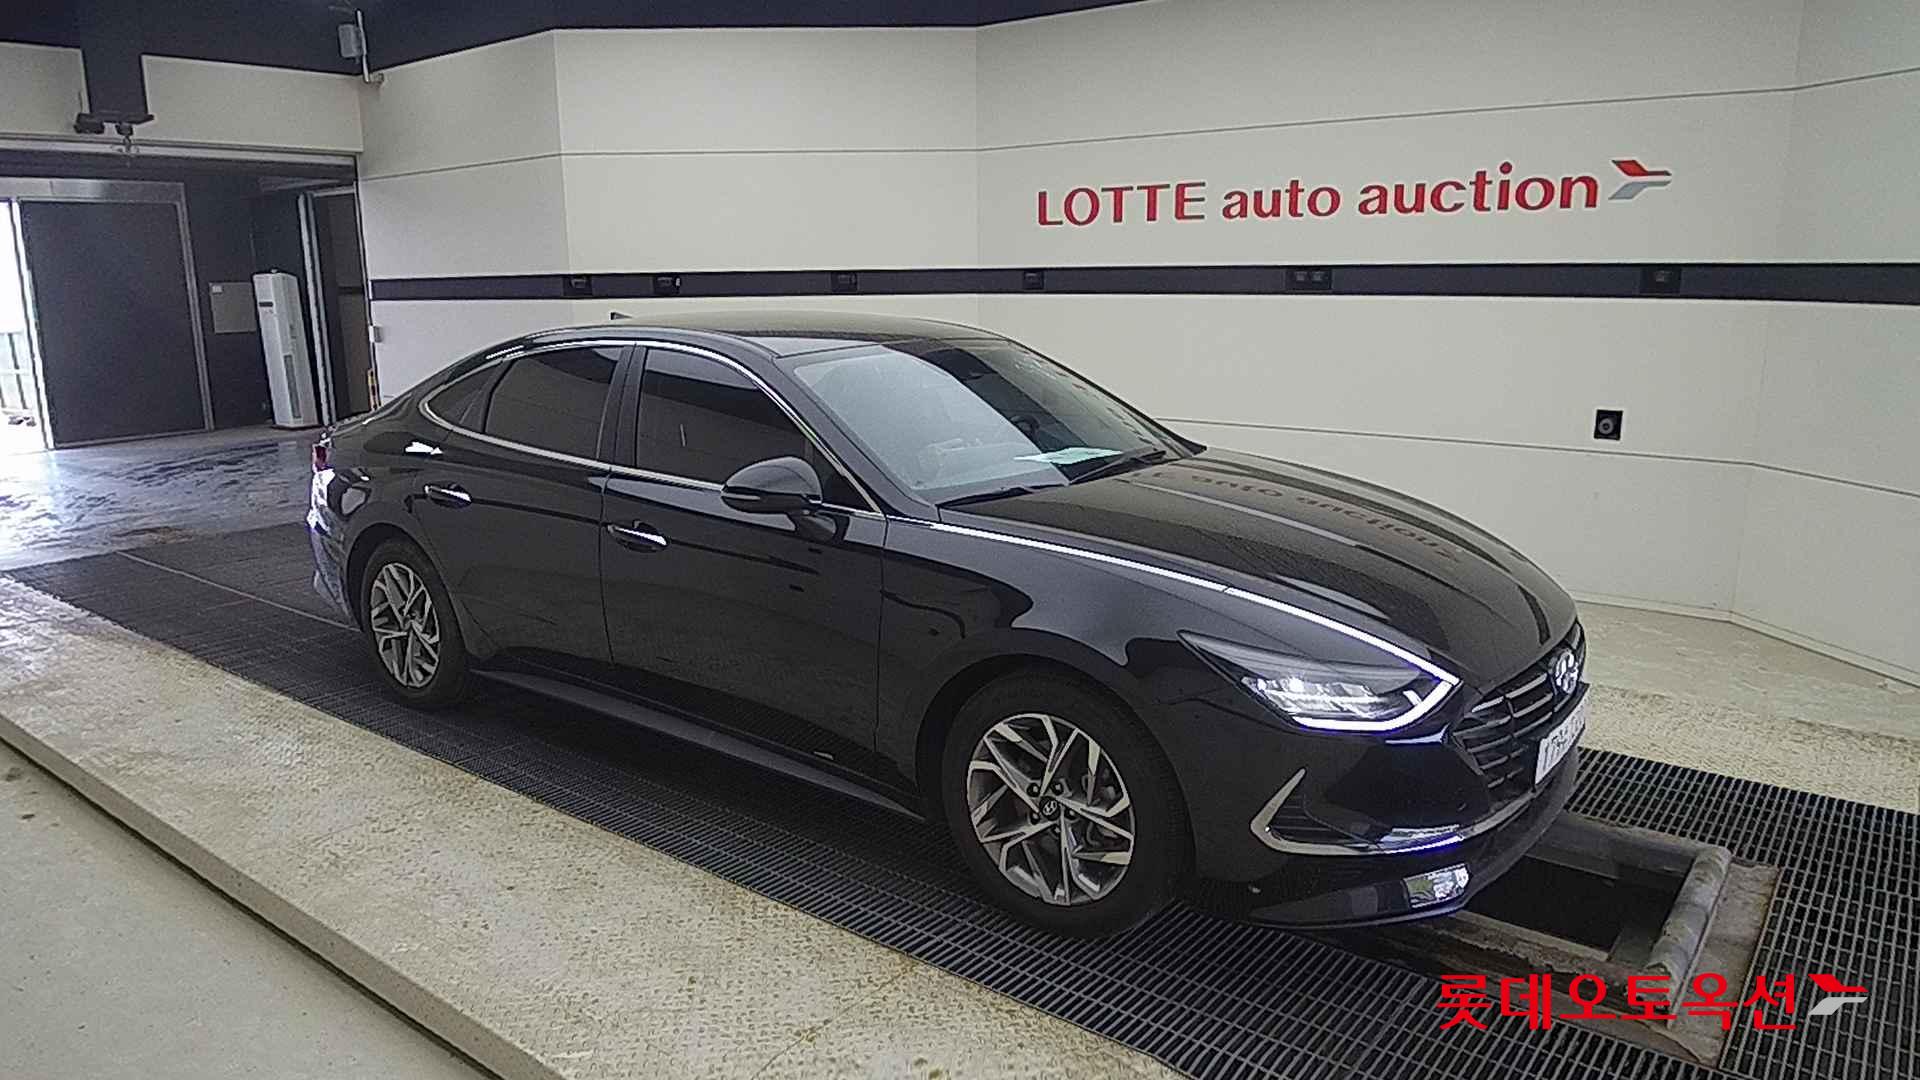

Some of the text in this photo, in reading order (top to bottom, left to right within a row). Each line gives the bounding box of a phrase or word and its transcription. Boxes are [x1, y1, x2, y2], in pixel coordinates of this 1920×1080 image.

[1038, 162, 1599, 226] LOTTE auto auction
